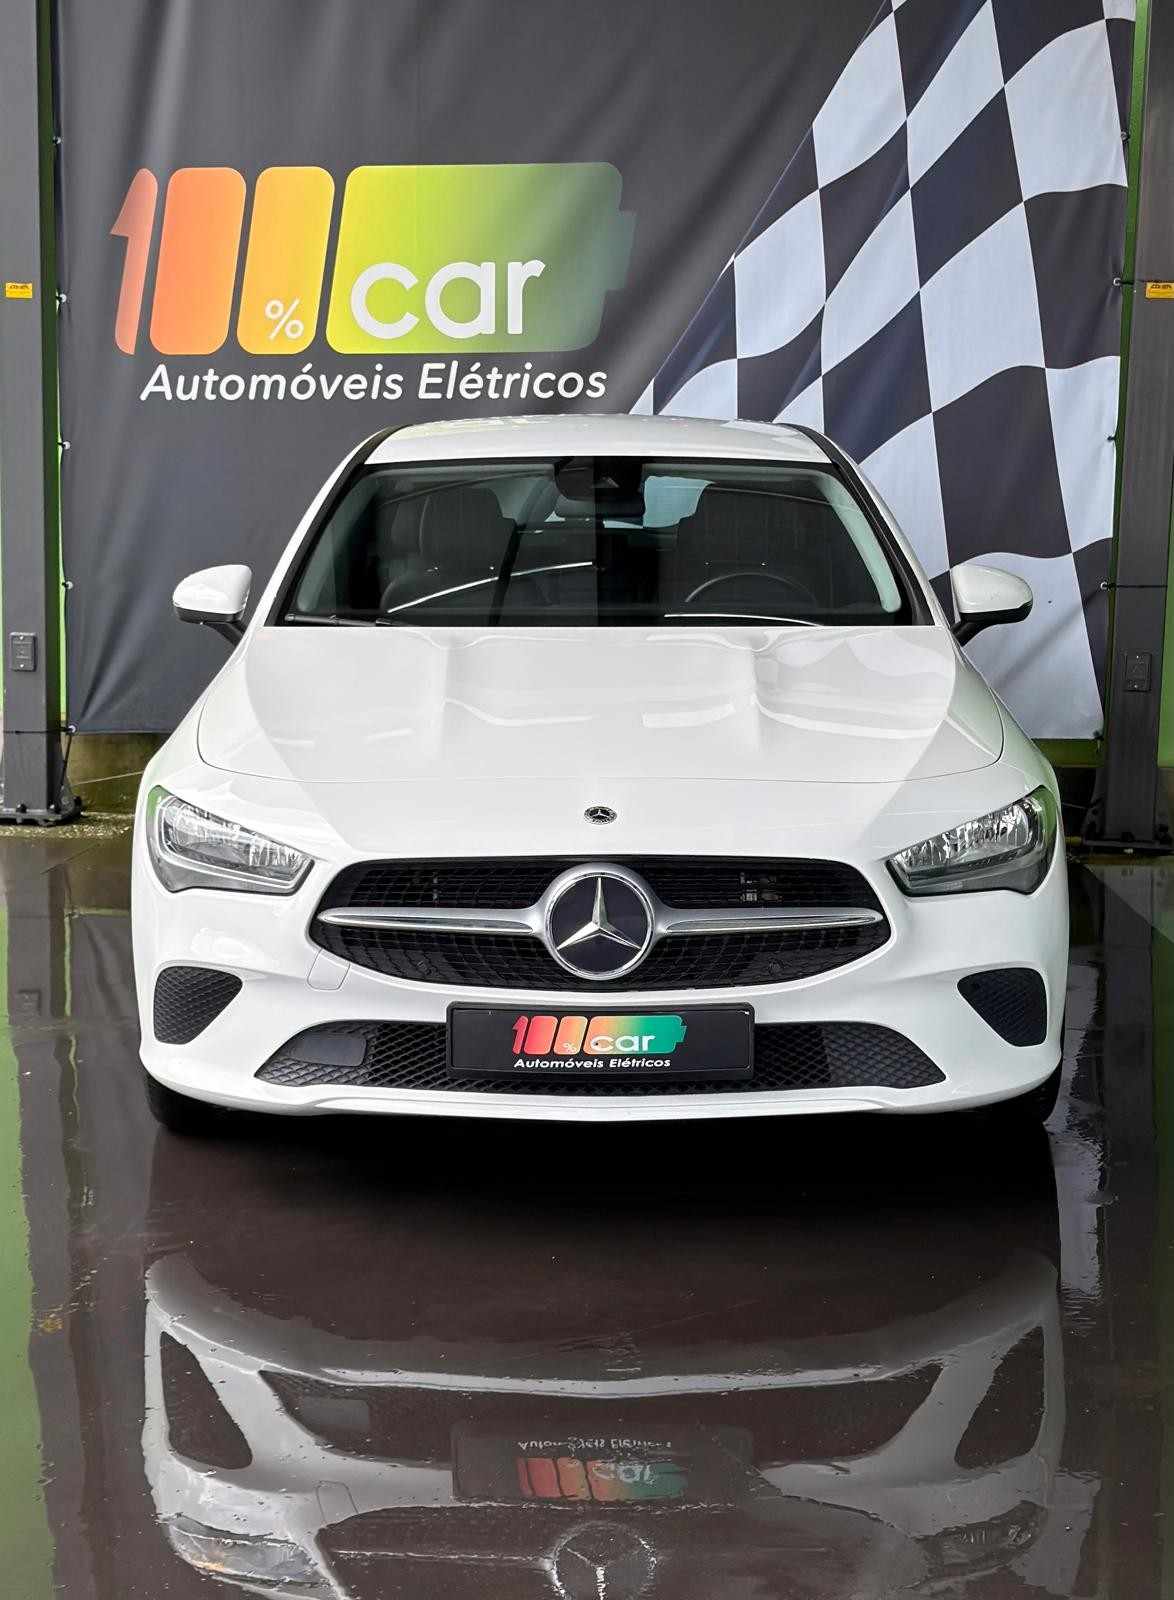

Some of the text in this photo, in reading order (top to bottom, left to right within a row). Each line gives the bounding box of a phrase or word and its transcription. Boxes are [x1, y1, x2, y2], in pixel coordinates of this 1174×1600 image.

[349, 259, 546, 340] car
[140, 360, 608, 401] Automóveis Elétricos
[590, 1033, 656, 1052] car
[513, 1056, 671, 1069] Automóveis Elétricos
